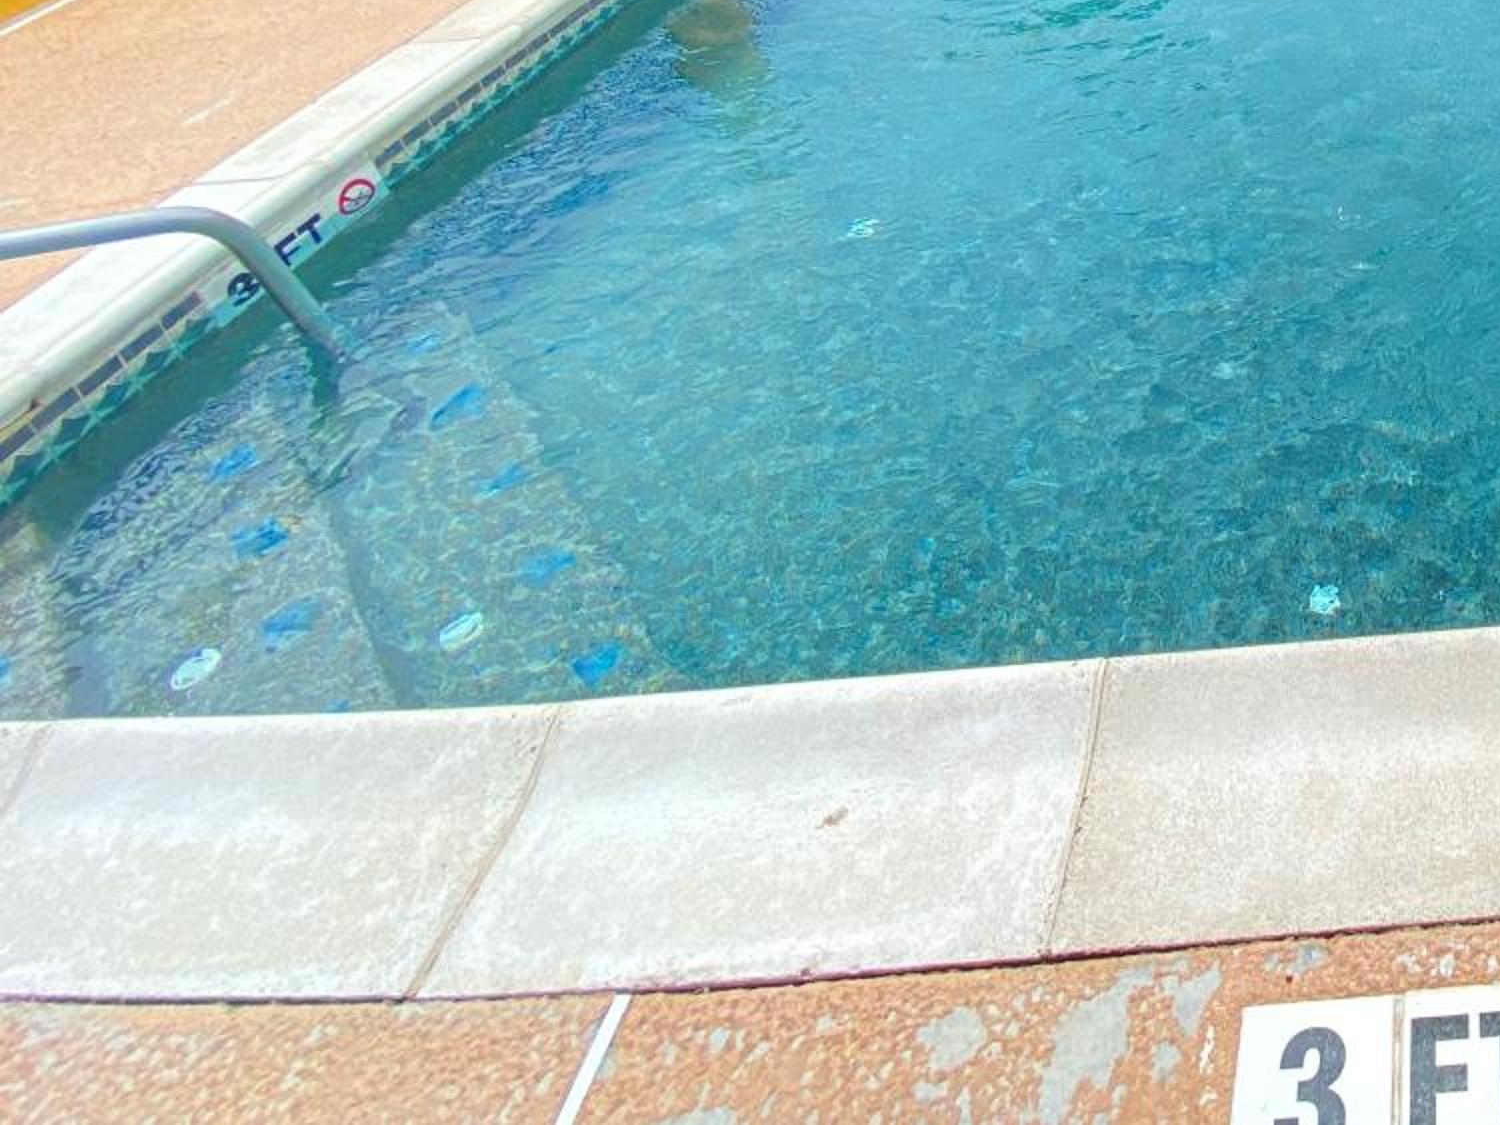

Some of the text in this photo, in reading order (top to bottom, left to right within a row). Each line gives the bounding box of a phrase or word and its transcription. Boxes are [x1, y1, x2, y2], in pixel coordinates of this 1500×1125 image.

[227, 213, 322, 306] 3 FT
[1272, 1026, 1347, 1125] 3
